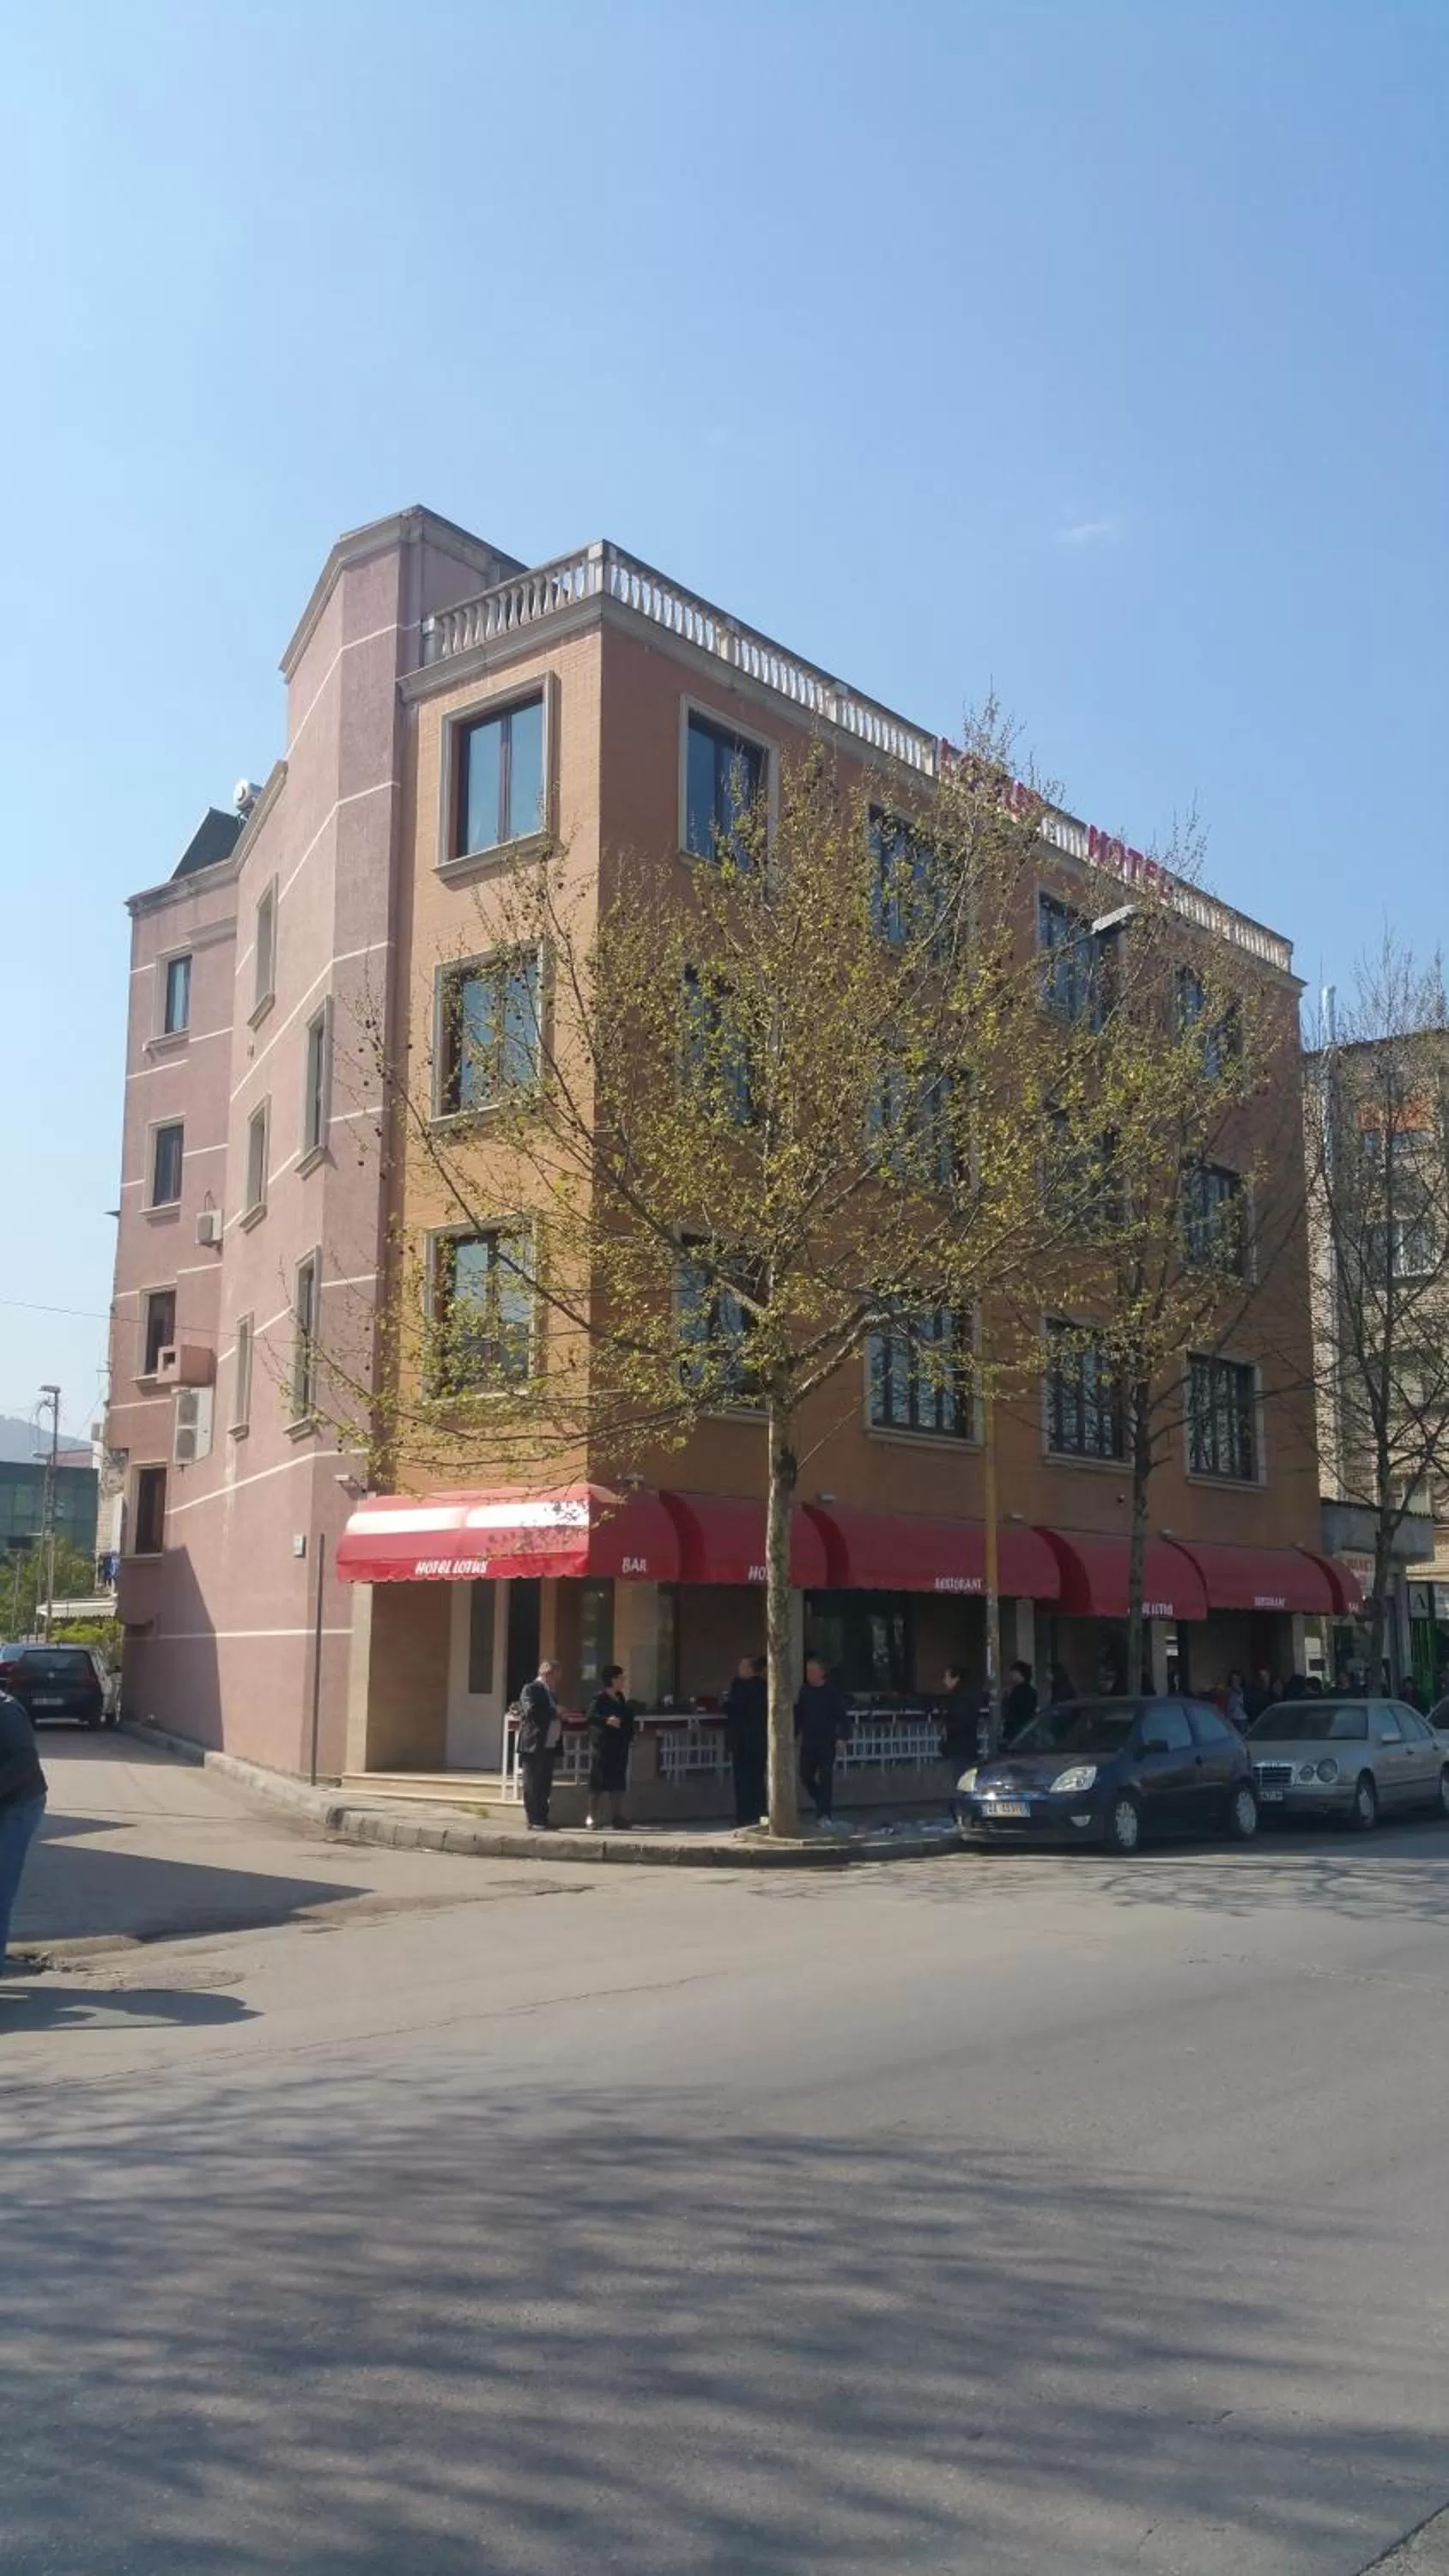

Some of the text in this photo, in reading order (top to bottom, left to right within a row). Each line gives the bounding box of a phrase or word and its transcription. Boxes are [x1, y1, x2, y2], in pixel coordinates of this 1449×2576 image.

[415, 1559, 488, 1575] HOTEL LOTUS
[622, 1557, 647, 1573] BAR
